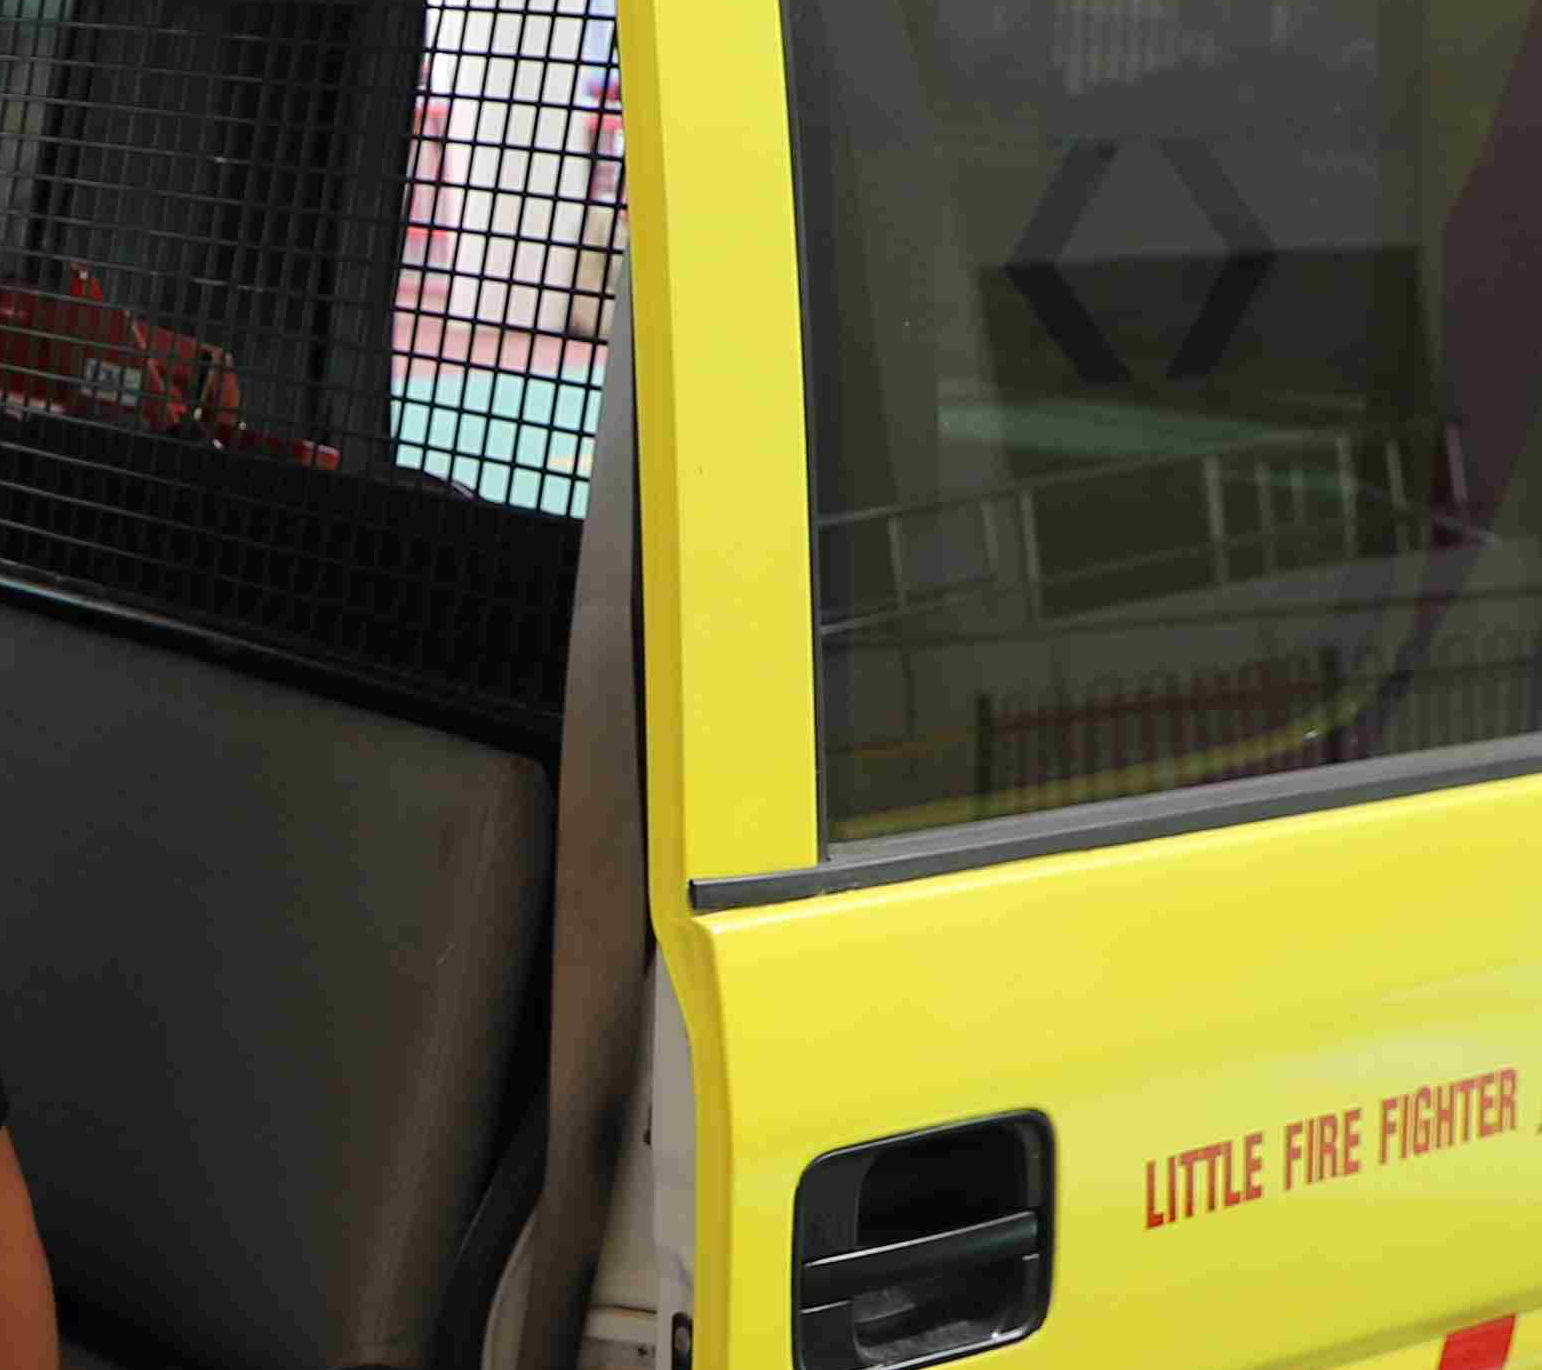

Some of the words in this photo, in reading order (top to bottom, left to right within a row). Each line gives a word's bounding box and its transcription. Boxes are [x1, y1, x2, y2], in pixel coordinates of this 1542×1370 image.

[1145, 1131, 1264, 1230] LITTLE
[1283, 1108, 1362, 1192] FIRE
[1378, 1067, 1519, 1165] FIGHTER
